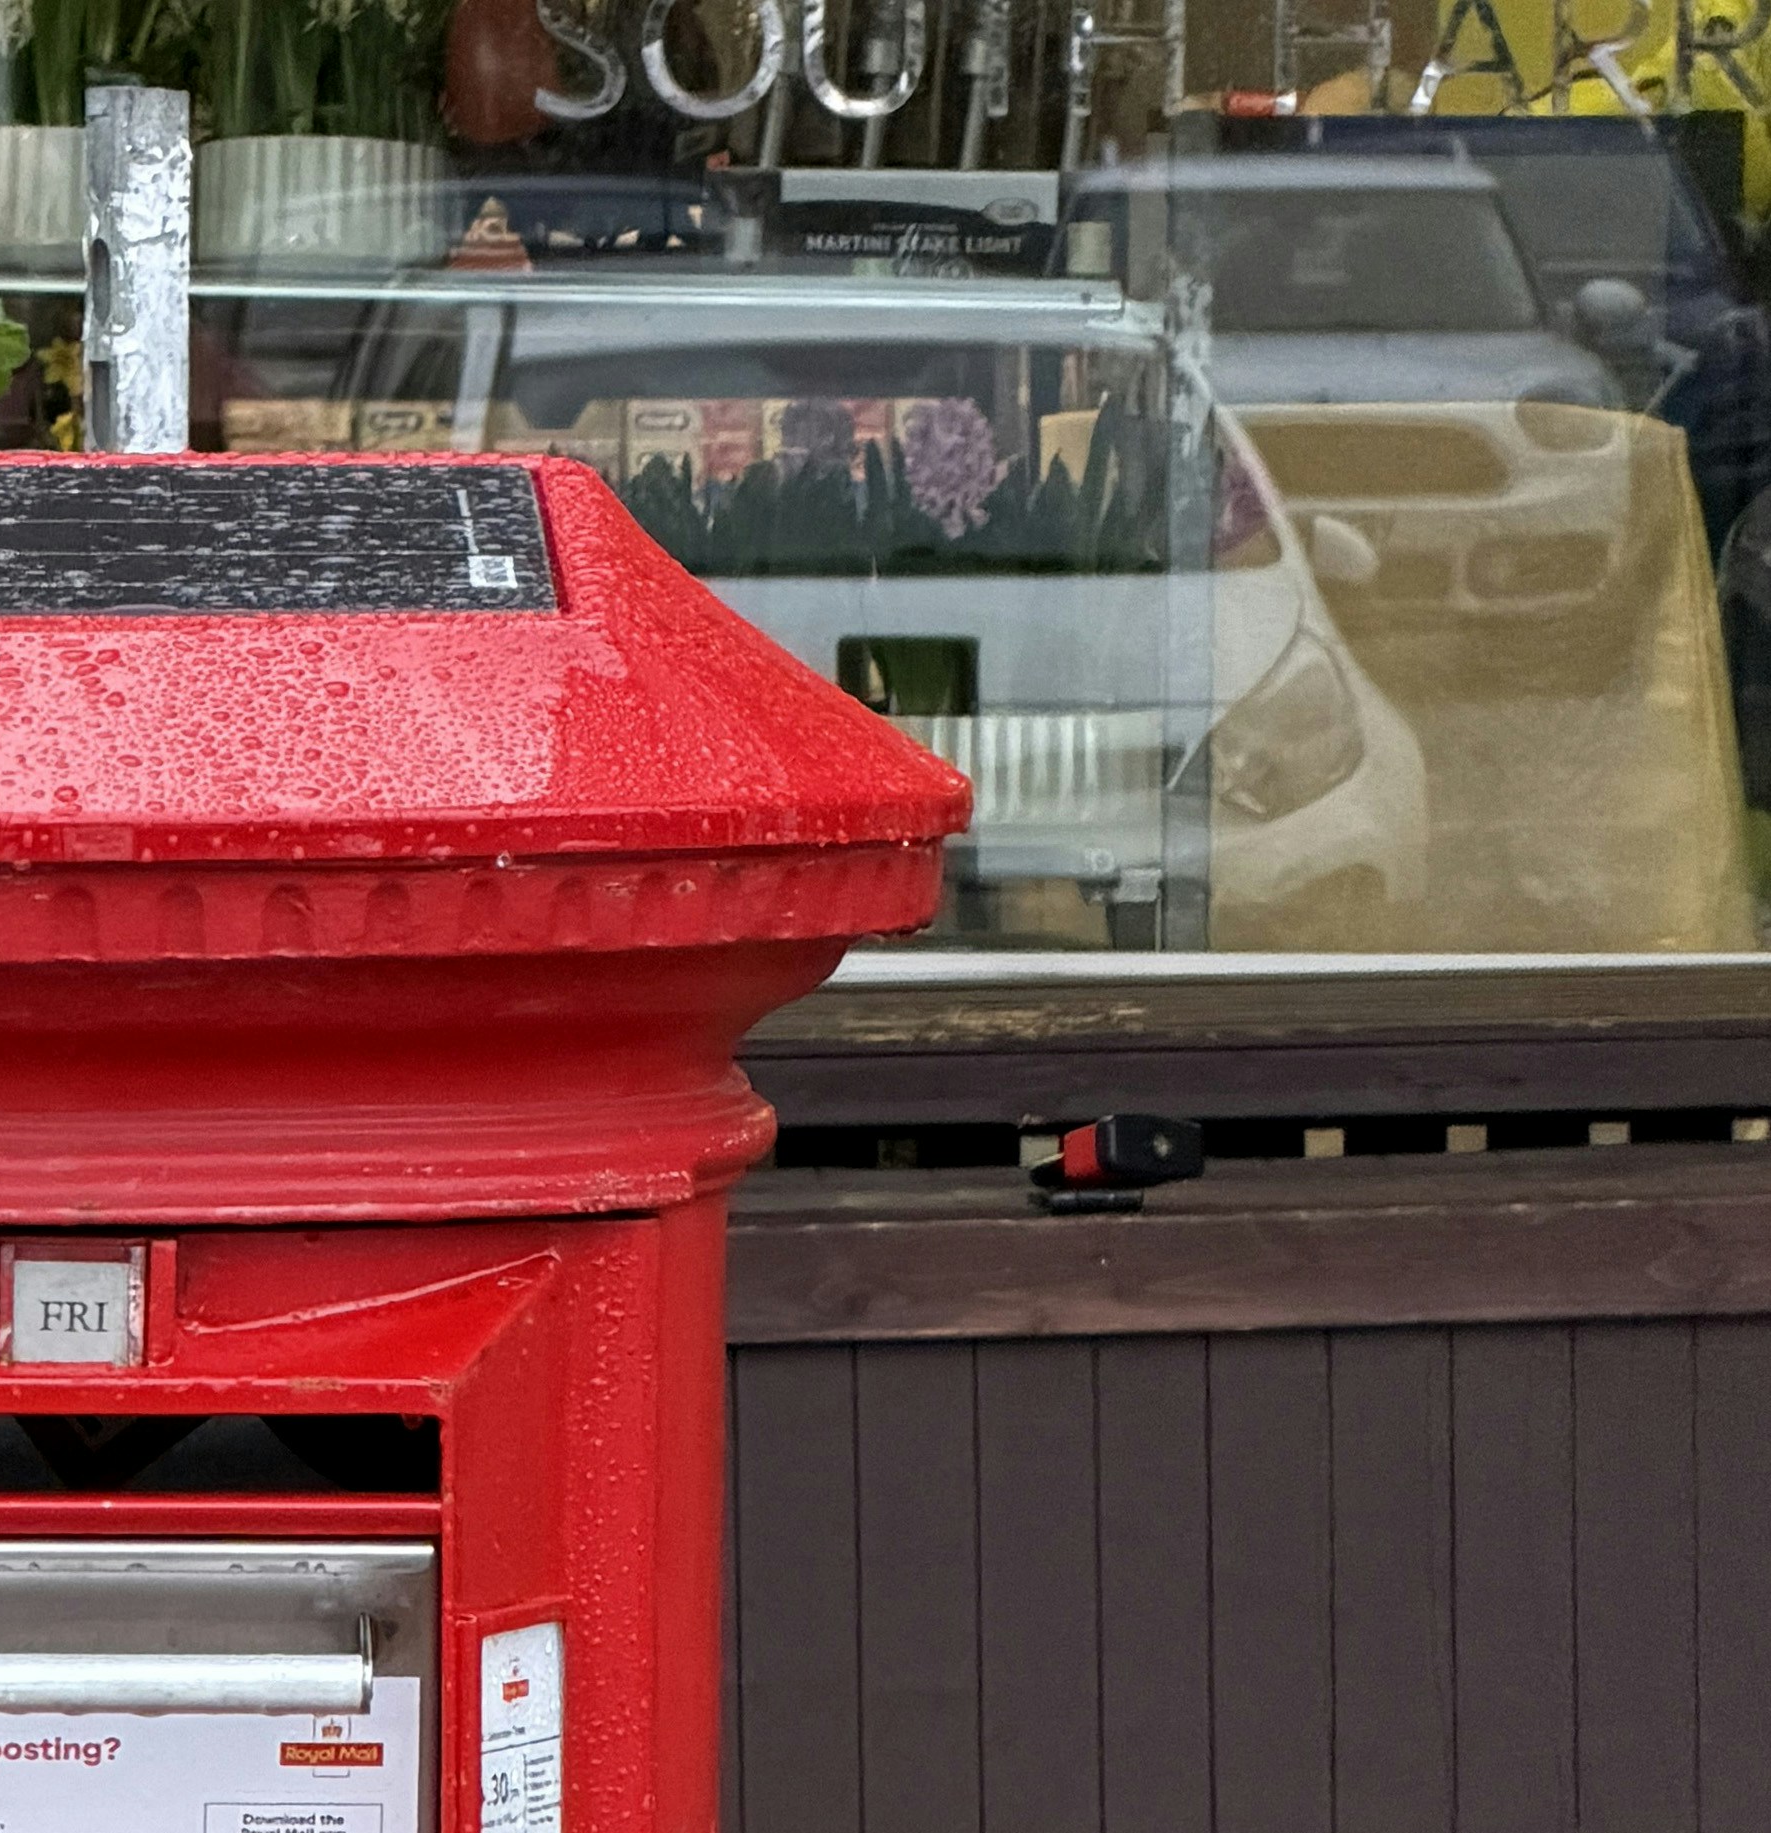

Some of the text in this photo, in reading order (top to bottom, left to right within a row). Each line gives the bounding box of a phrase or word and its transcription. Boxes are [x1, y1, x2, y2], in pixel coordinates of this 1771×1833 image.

[534, 0, 1186, 119] SOUTH
[804, 234, 891, 253] MARTINI
[964, 235, 1023, 252] LIGHT
[38, 1301, 109, 1334] FRI
[284, 1746, 379, 1764] Royal Mail
[242, 1812, 345, 1827] Download the
